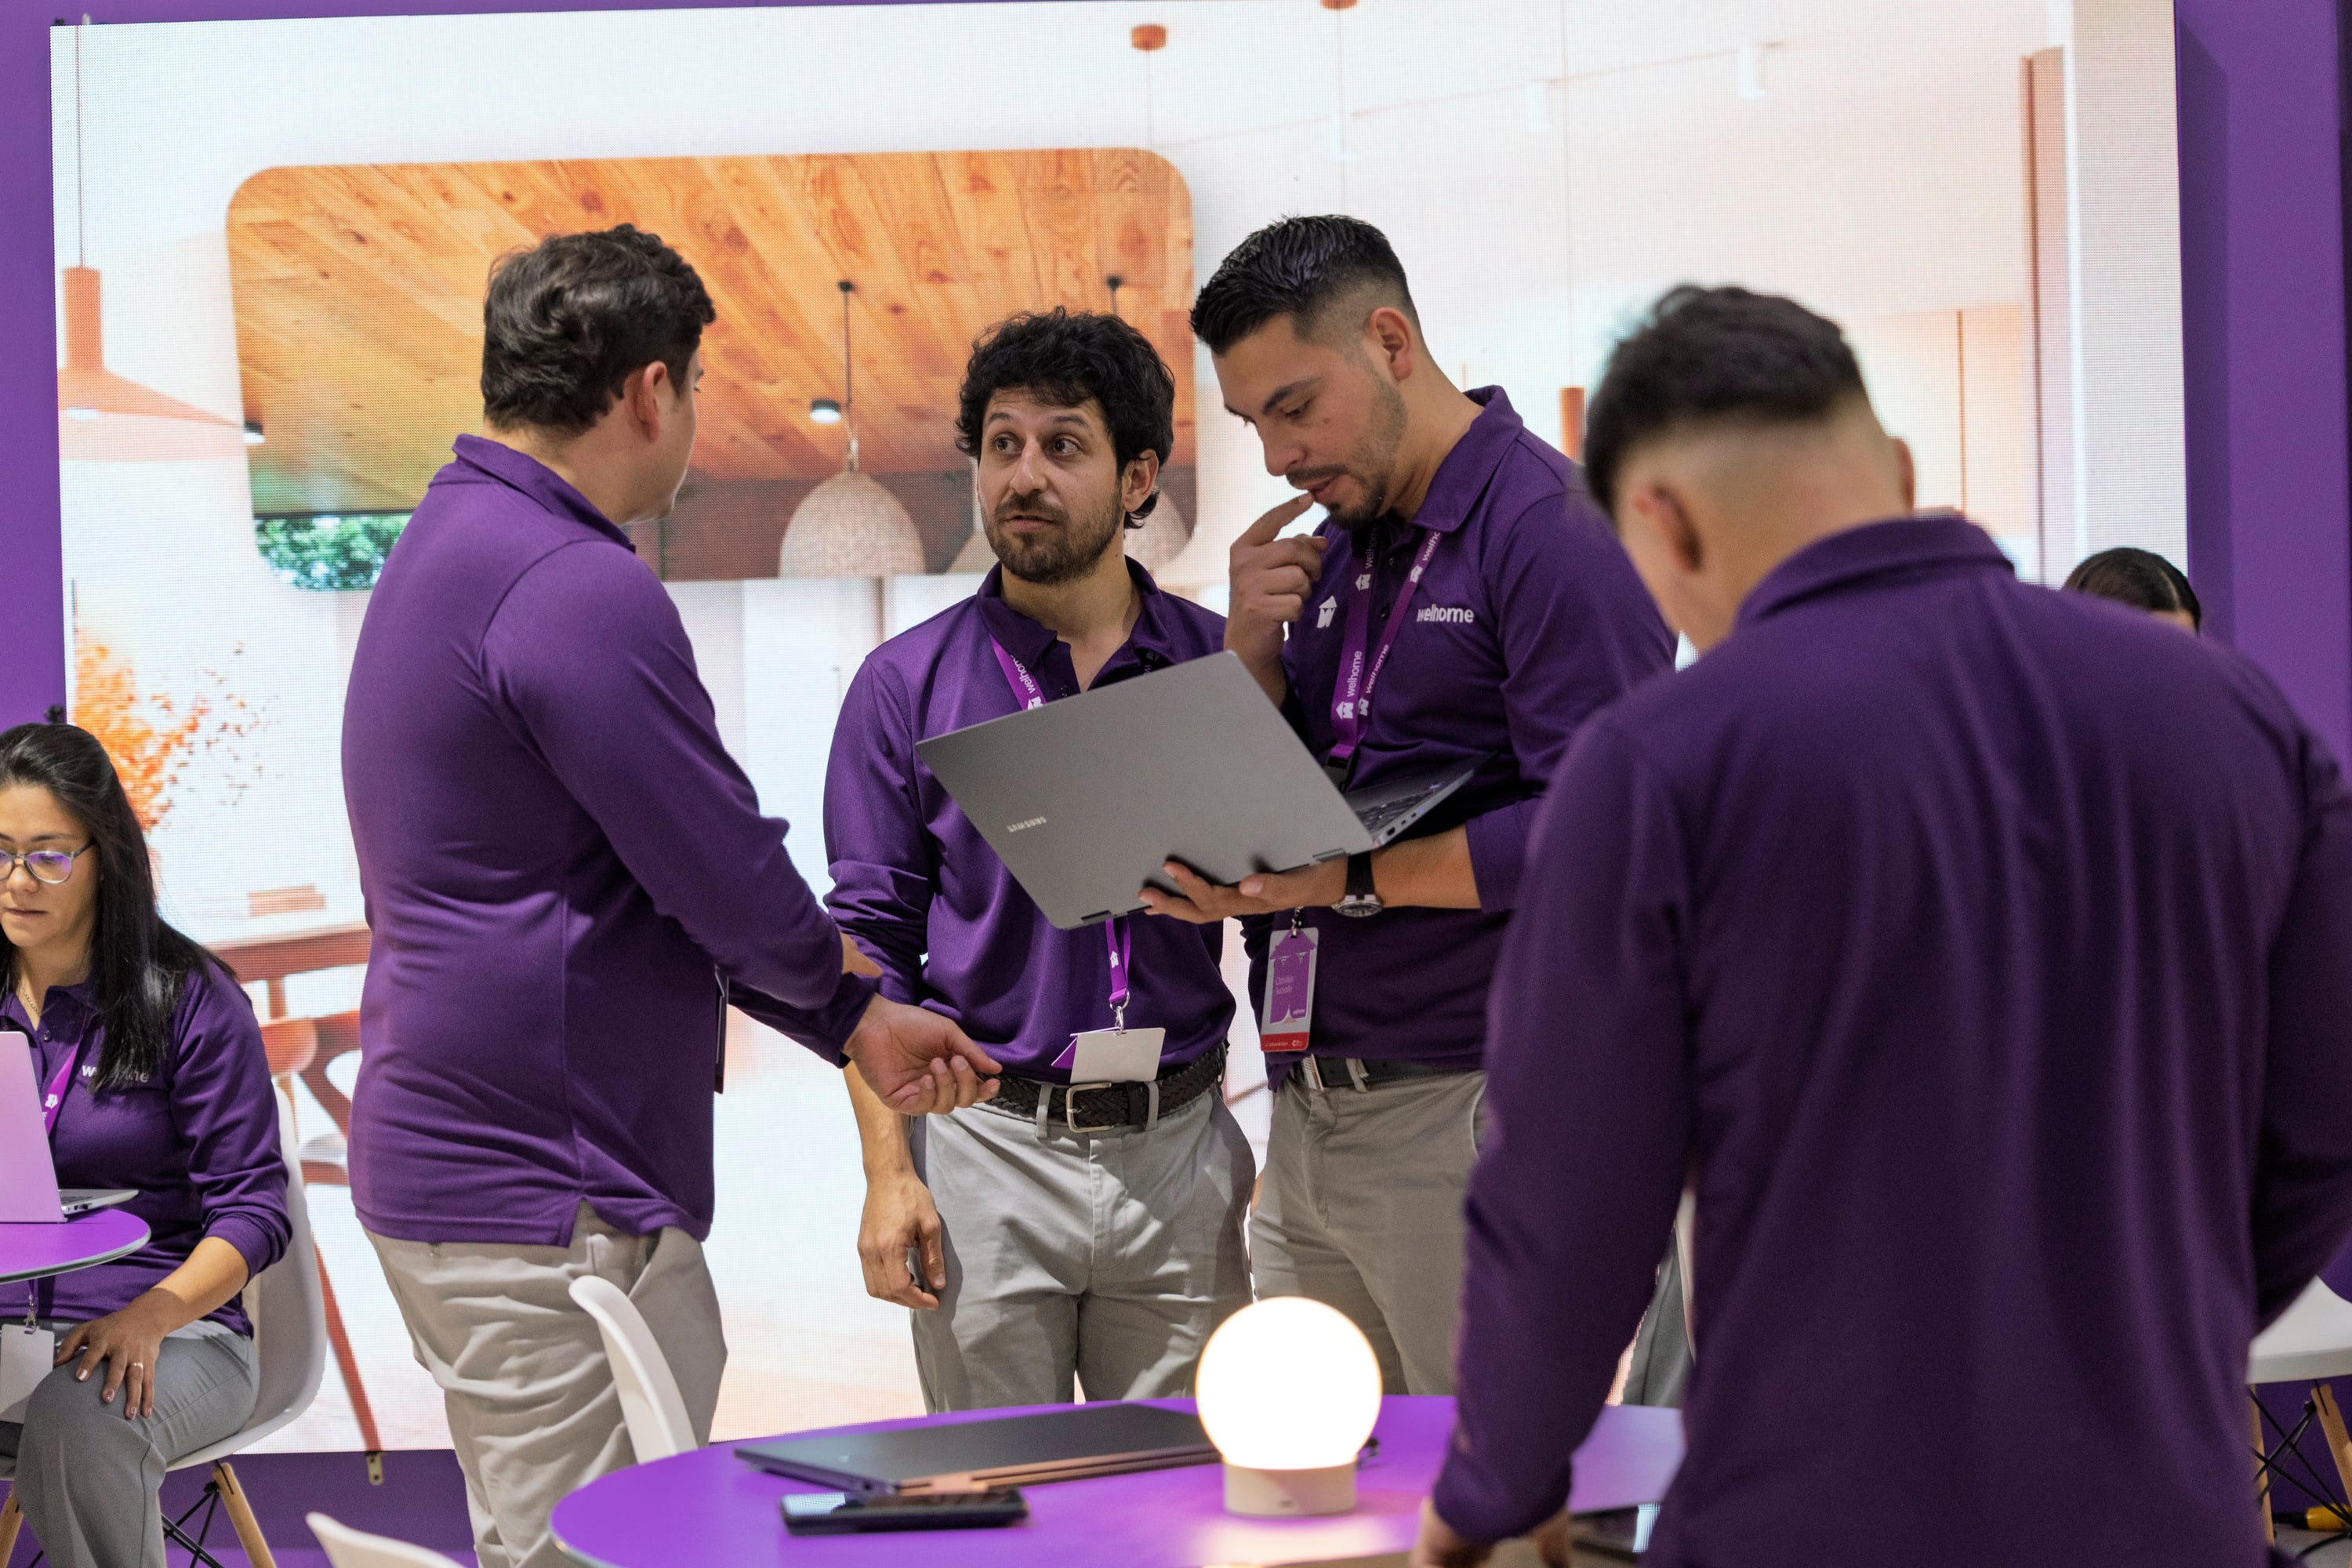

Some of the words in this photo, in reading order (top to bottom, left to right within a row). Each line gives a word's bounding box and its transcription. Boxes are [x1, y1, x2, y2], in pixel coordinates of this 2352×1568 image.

[1365, 526, 1380, 569] welhom
[1417, 604, 1474, 623] welhome
[1010, 654, 1036, 694] welhom
[1346, 650, 1363, 698] welhome
[1366, 644, 1389, 695] welhome
[1006, 816, 1047, 833] SAMSUNG
